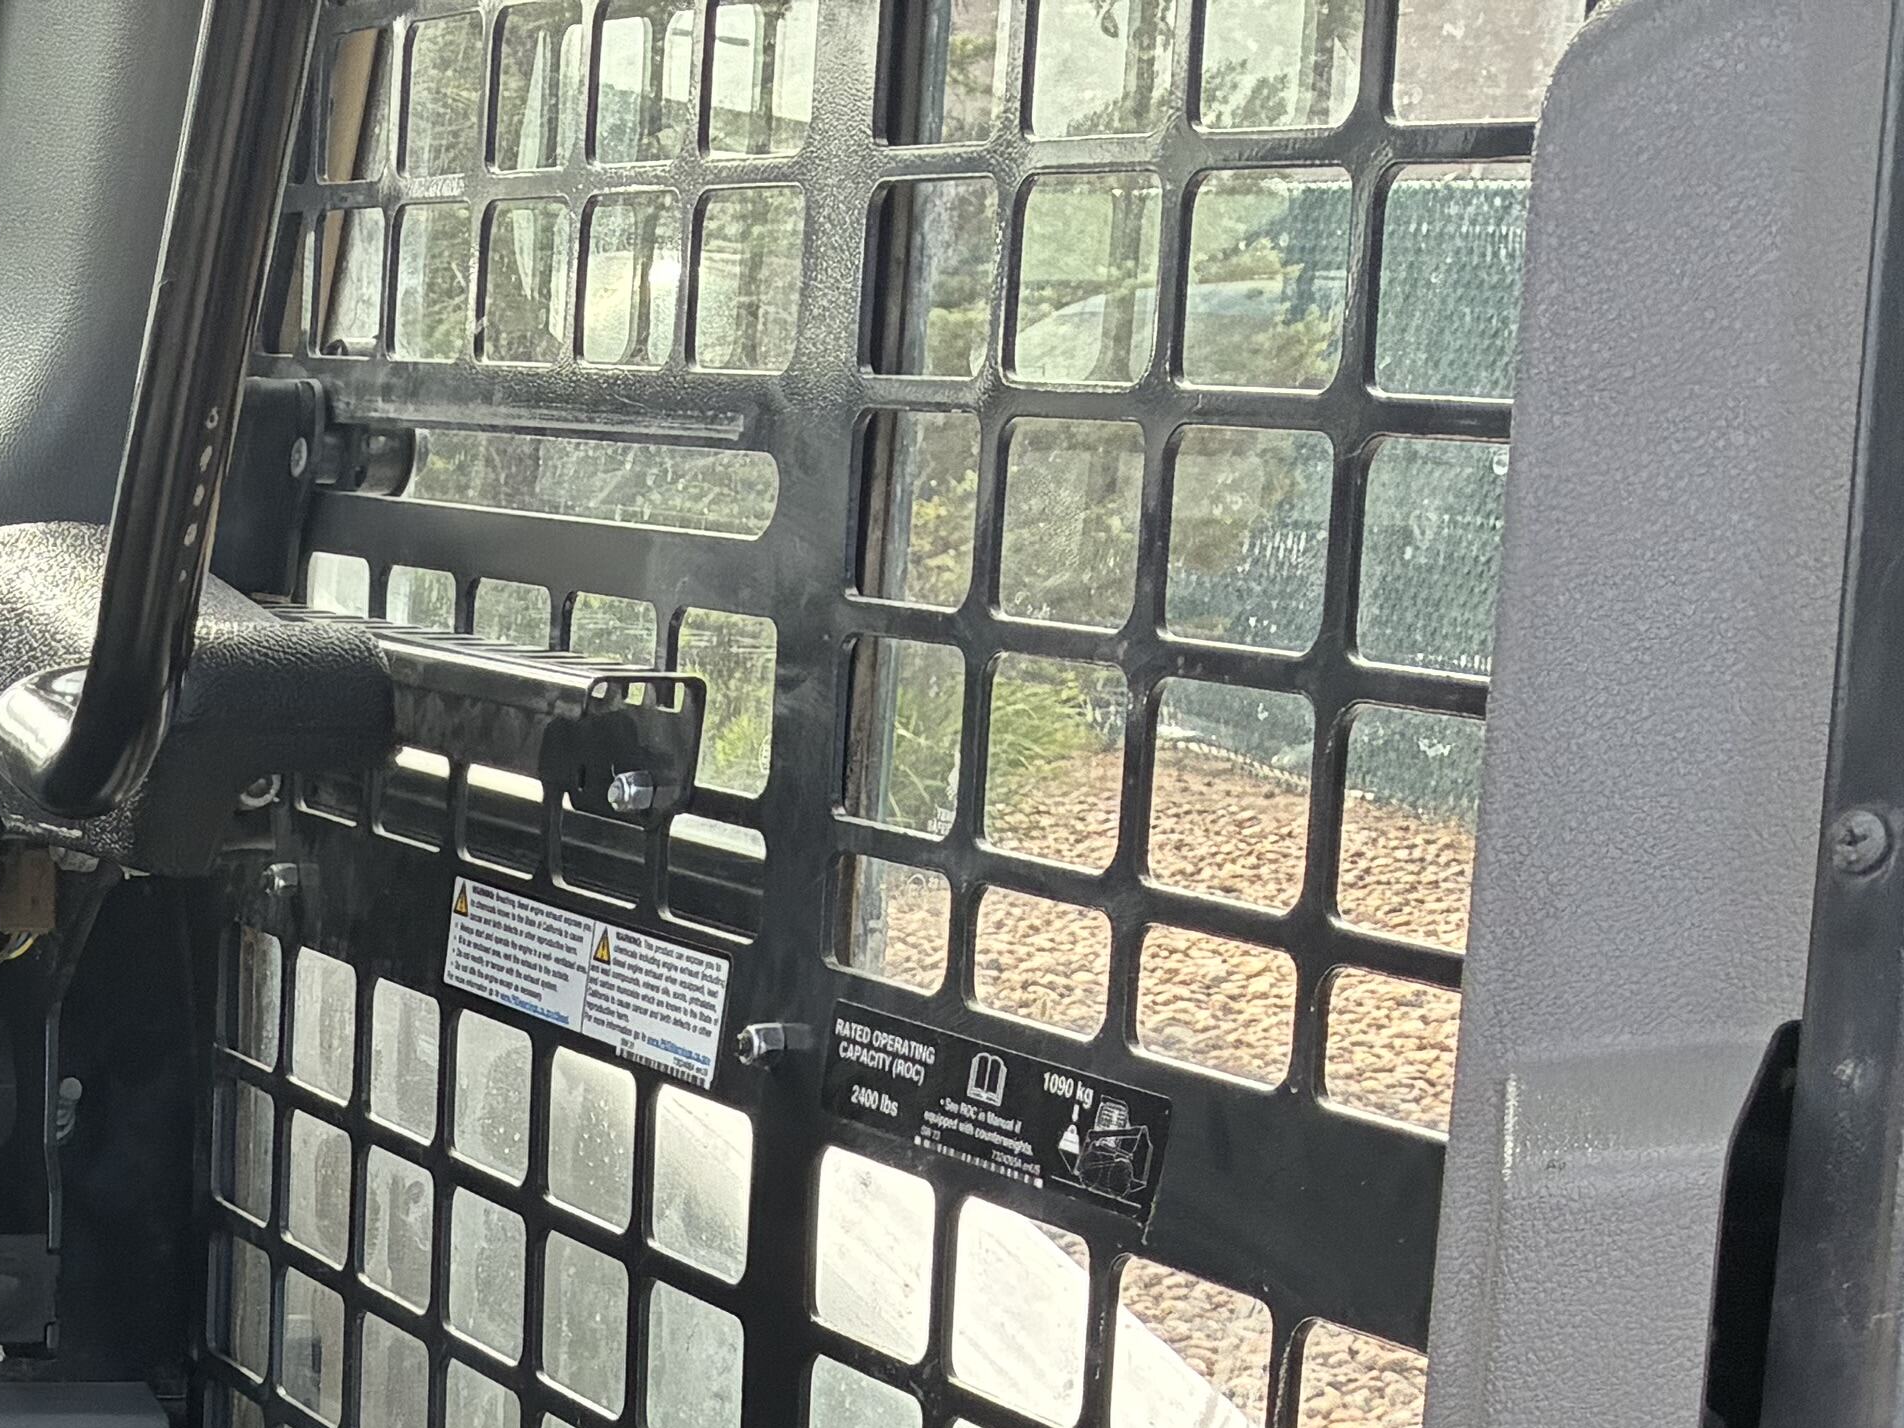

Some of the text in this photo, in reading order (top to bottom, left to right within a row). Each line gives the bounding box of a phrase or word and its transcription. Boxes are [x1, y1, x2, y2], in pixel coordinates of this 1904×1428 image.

[836, 1018, 934, 1064] RATED OPERATING
[839, 1041, 924, 1086] CAPACITY (ROC)
[851, 1084, 898, 1115] 2400 lbs
[1042, 1072, 1093, 1108] 1090 kg
